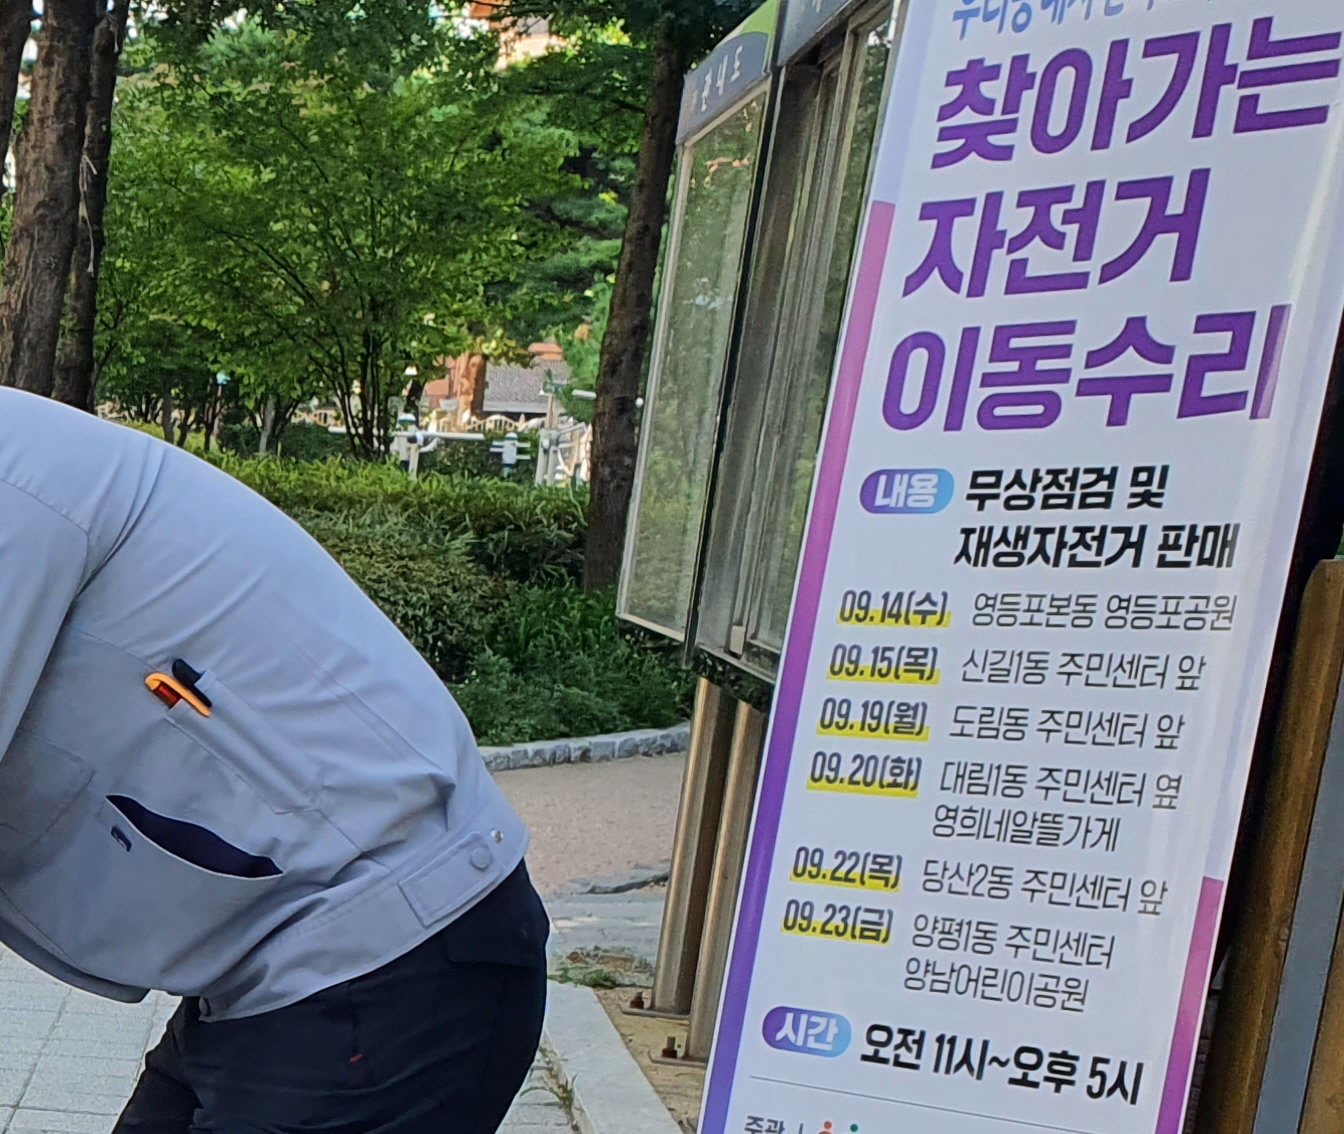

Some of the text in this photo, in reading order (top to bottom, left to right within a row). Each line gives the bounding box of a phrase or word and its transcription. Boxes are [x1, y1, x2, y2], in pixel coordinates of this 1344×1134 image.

[931, 17, 1341, 169] 찾아가는
[902, 168, 1211, 298] 자전거
[882, 304, 1292, 432] 이동수리
[874, 465, 1168, 512] 내용 무상점검 및
[953, 522, 1240, 569] 재생자전거 판매
[838, 590, 1235, 632] 09.14(수) 영등포본동 영등포공원
[829, 643, 1207, 692] 09.15(목) 신길1동 주민센터 앞
[819, 697, 1184, 751] 09.19(월) 도림동 주민센터 앞
[810, 750, 1183, 811] 09.20(화) 대림1동 주민센터 옆
[932, 804, 1120, 853] 영희네알뜰가게
[792, 846, 1167, 917] 09.22(목) 당산2동 주민센터 앞
[783, 900, 1115, 970] 09.23(금) 양평1동 주민센터
[904, 957, 1088, 1013] 양남어린이공원
[775, 1012, 1144, 1106] 시간 오전 11시~오후 5시
